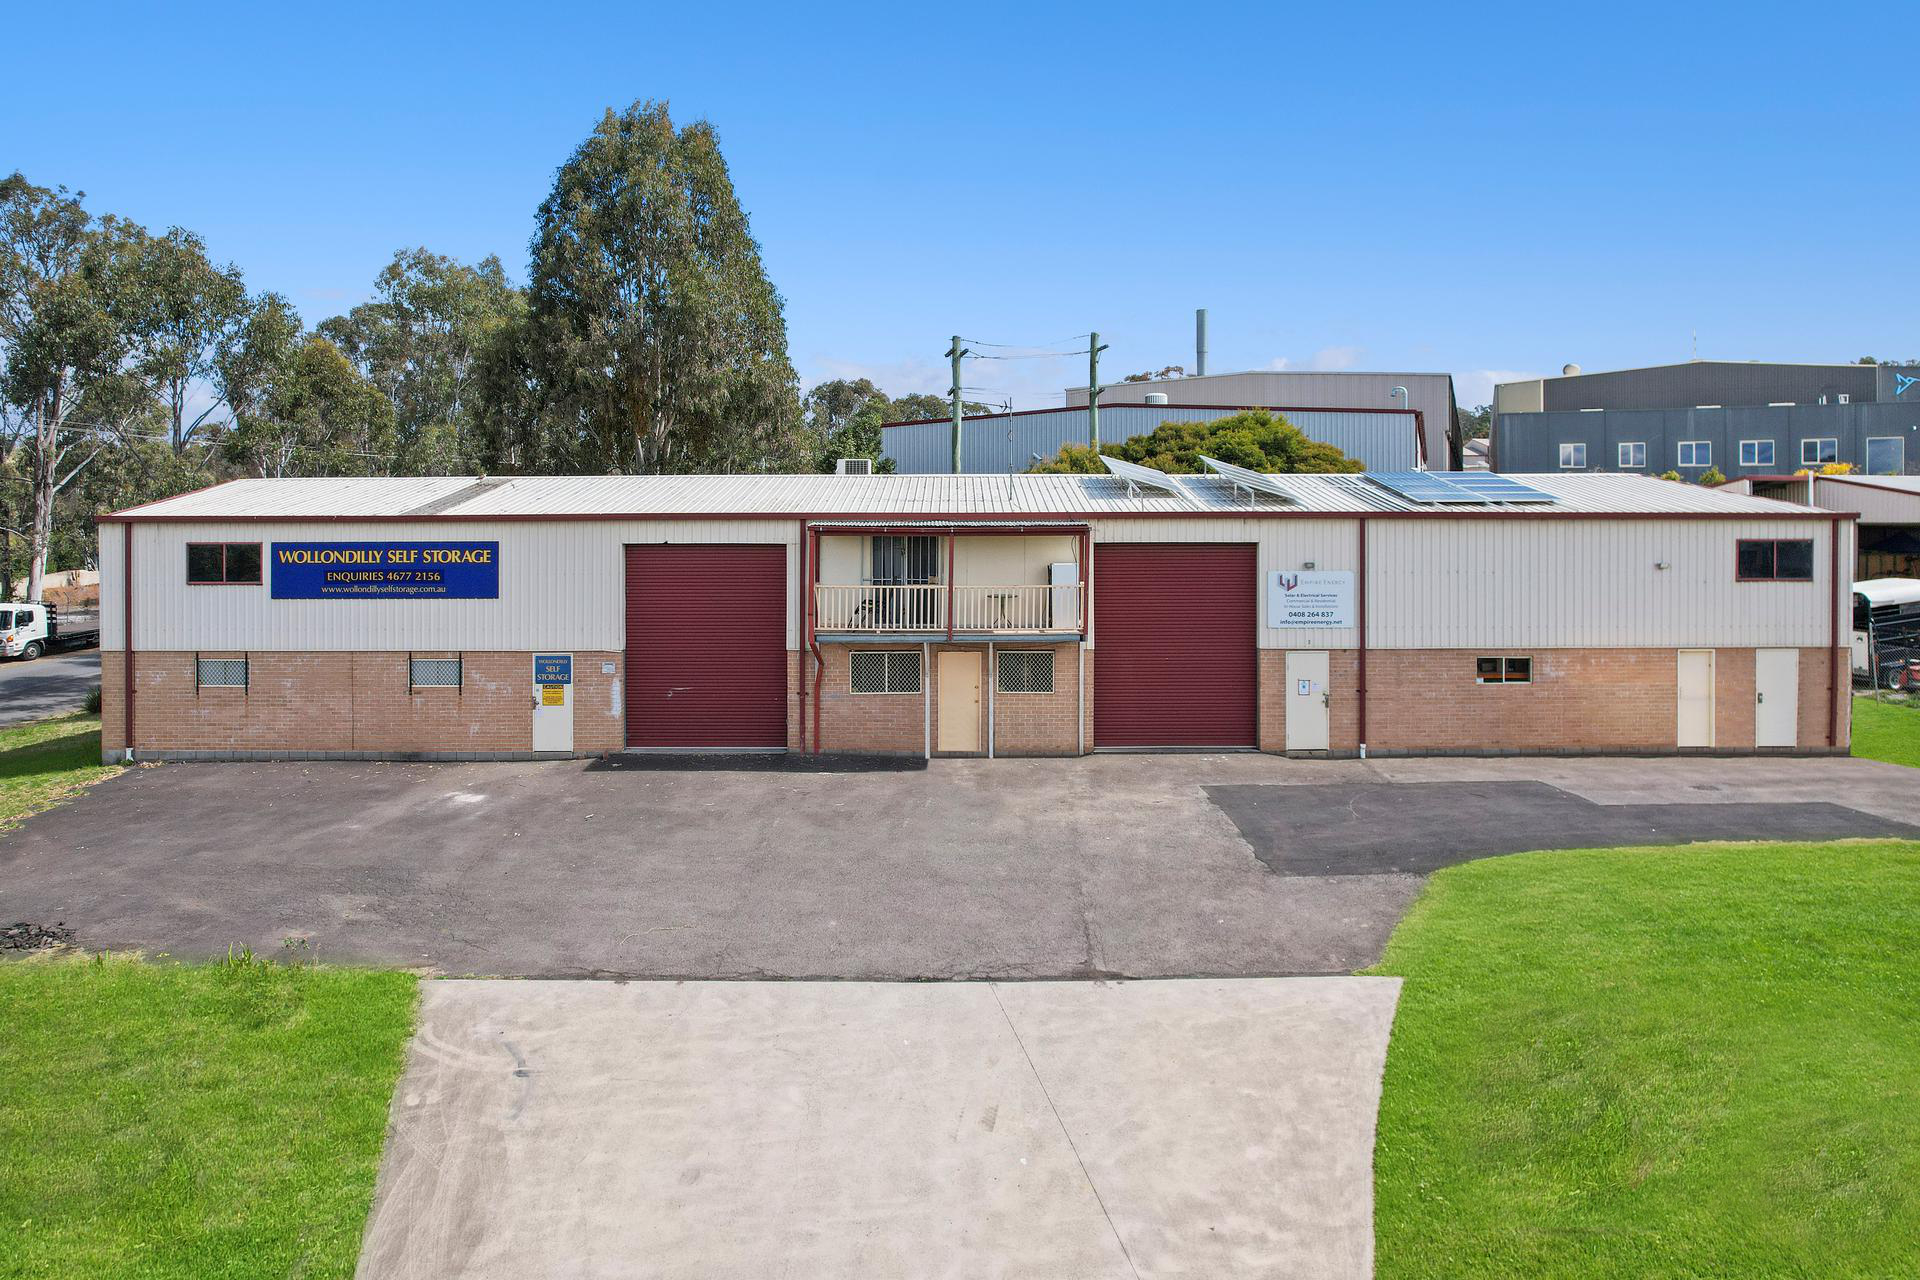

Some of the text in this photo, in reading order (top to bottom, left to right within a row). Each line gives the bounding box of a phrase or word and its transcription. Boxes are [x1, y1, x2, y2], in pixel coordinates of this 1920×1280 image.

[278, 549, 492, 564] WOLLONDILLY SELF STORAGE
[327, 571, 441, 582] ENQUIRIES 4677 2156
[321, 584, 446, 595] www.wollondillyselfstorage.com.au
